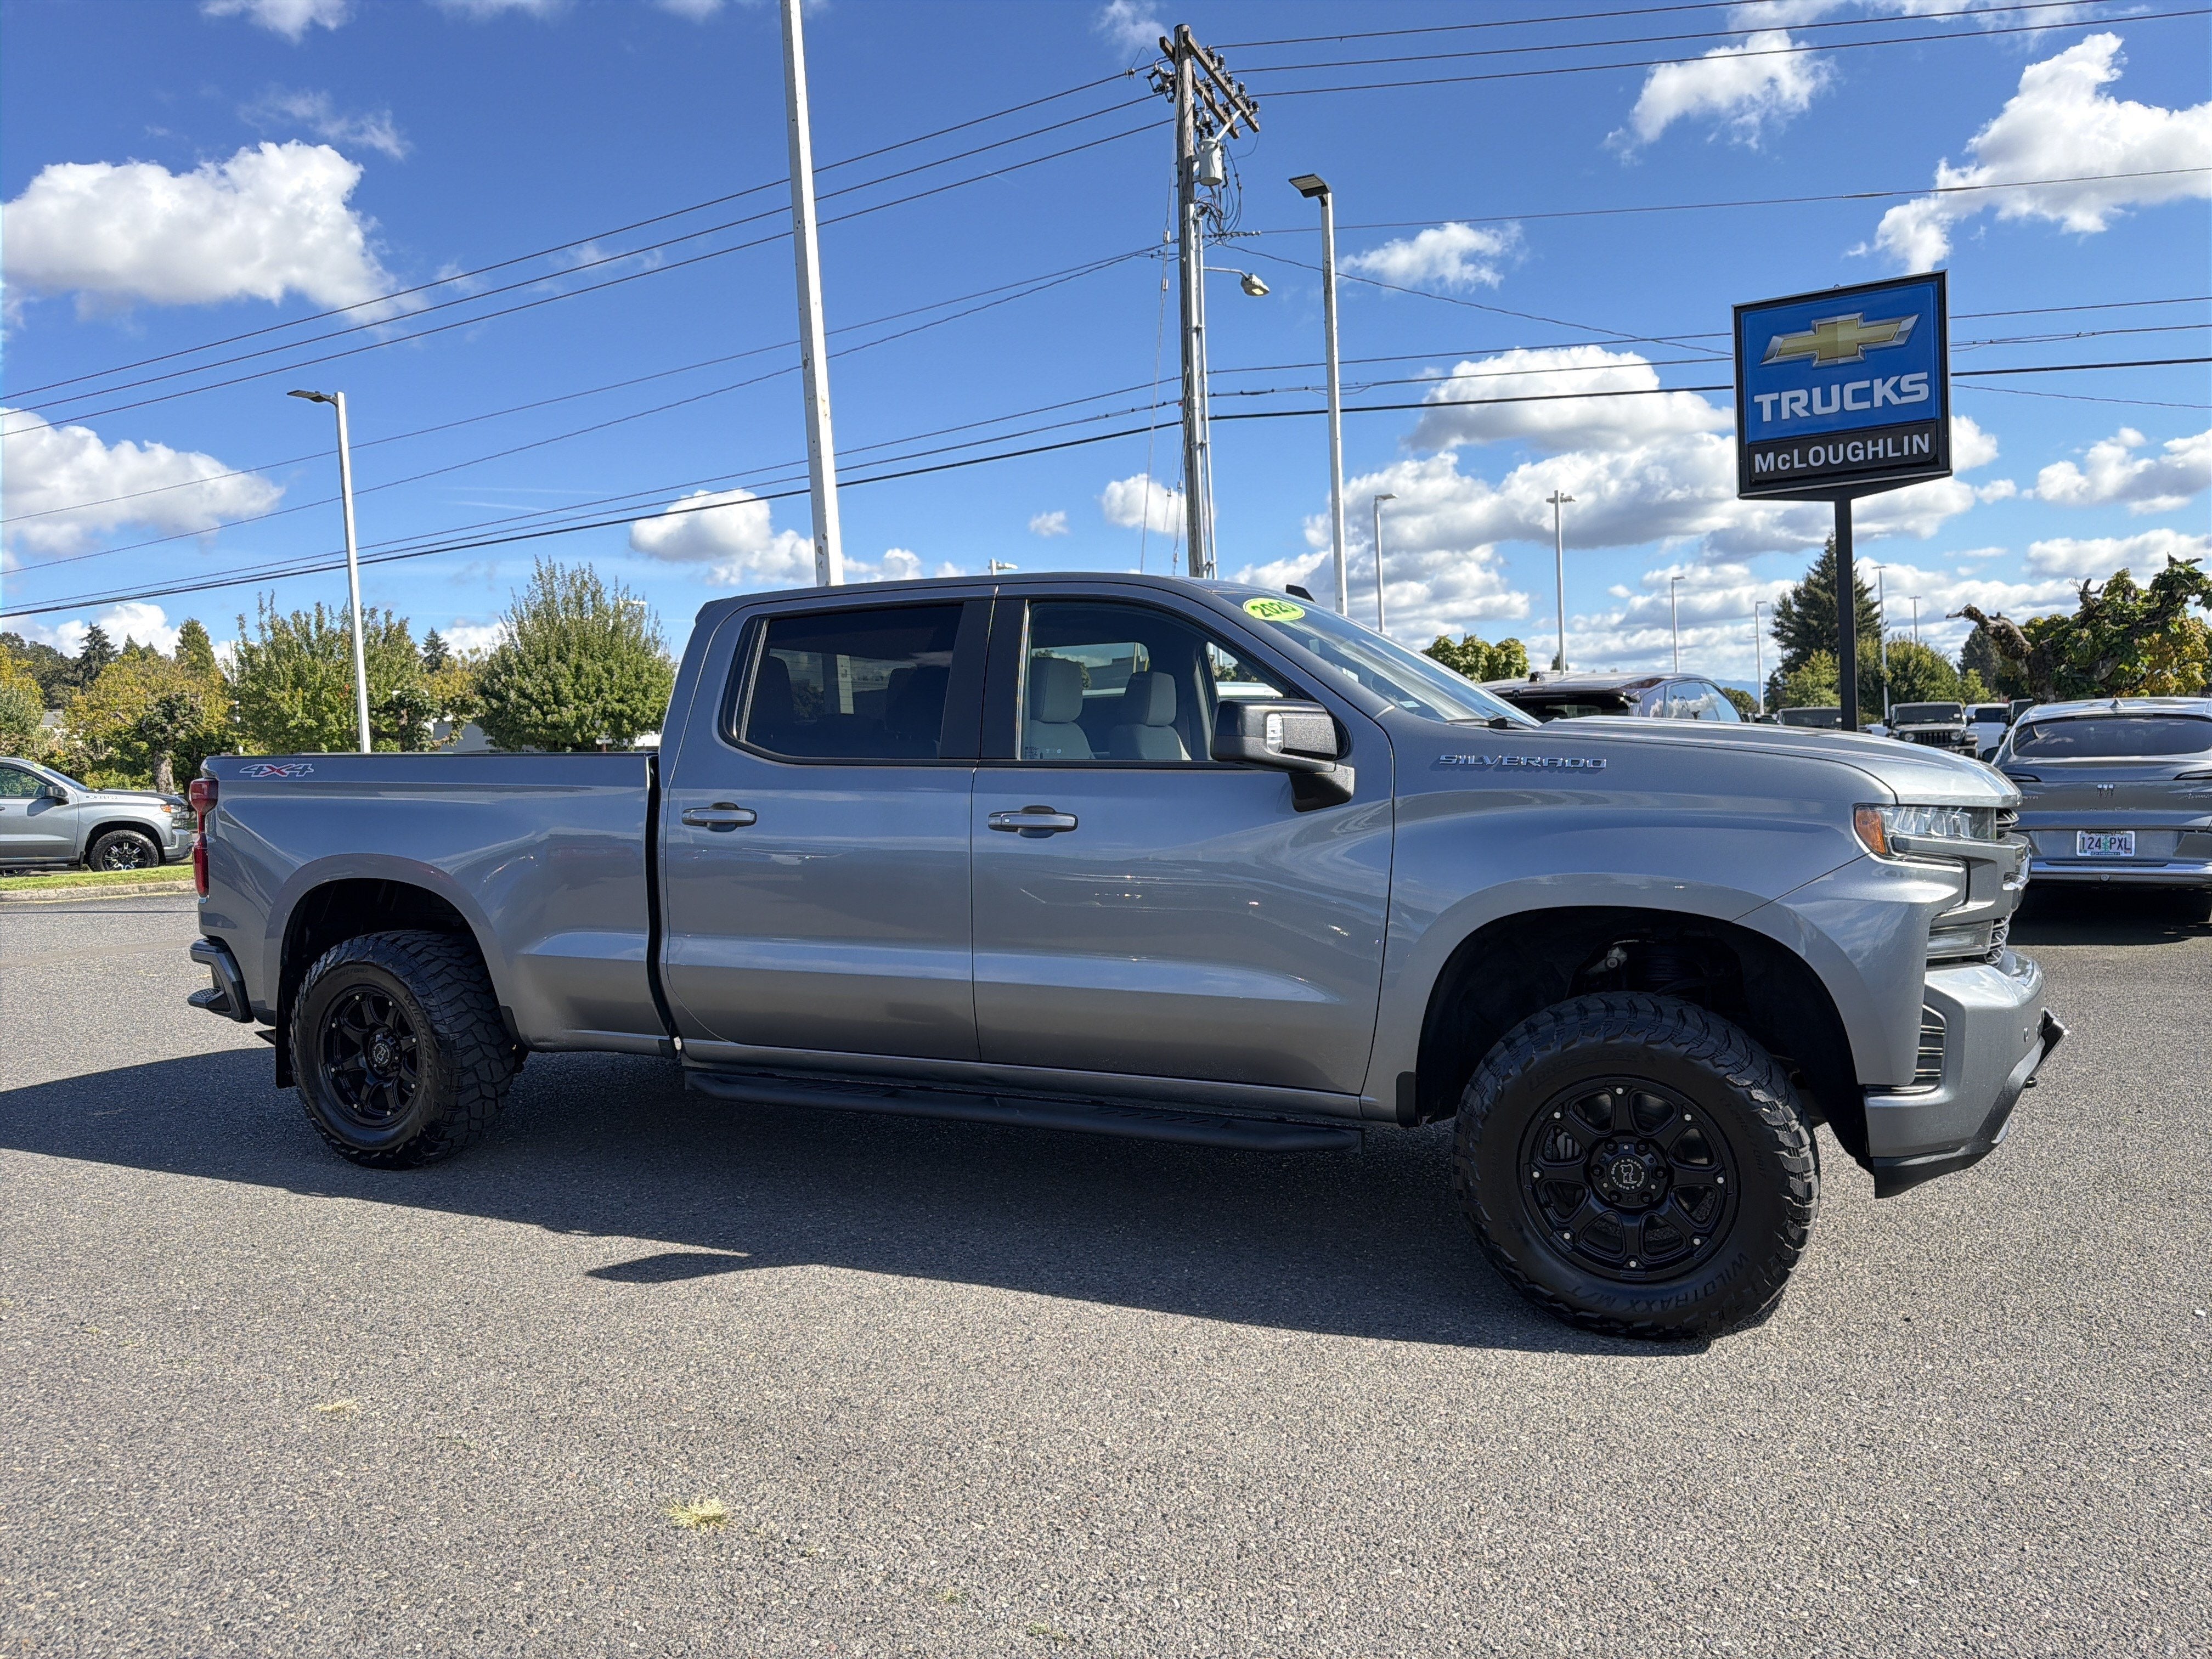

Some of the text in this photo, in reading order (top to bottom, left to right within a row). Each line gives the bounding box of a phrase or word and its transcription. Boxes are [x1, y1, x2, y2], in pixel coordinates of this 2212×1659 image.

[1754, 372, 1929, 422] TRUCKS
[1755, 433, 1929, 473] McLOUGHLIN
[1251, 601, 1297, 618] 2020
[1440, 754, 1606, 768] SILVERADO
[2081, 837, 2131, 850] 124 PXL
[1626, 1252, 1749, 1312] WILDTRAXX
